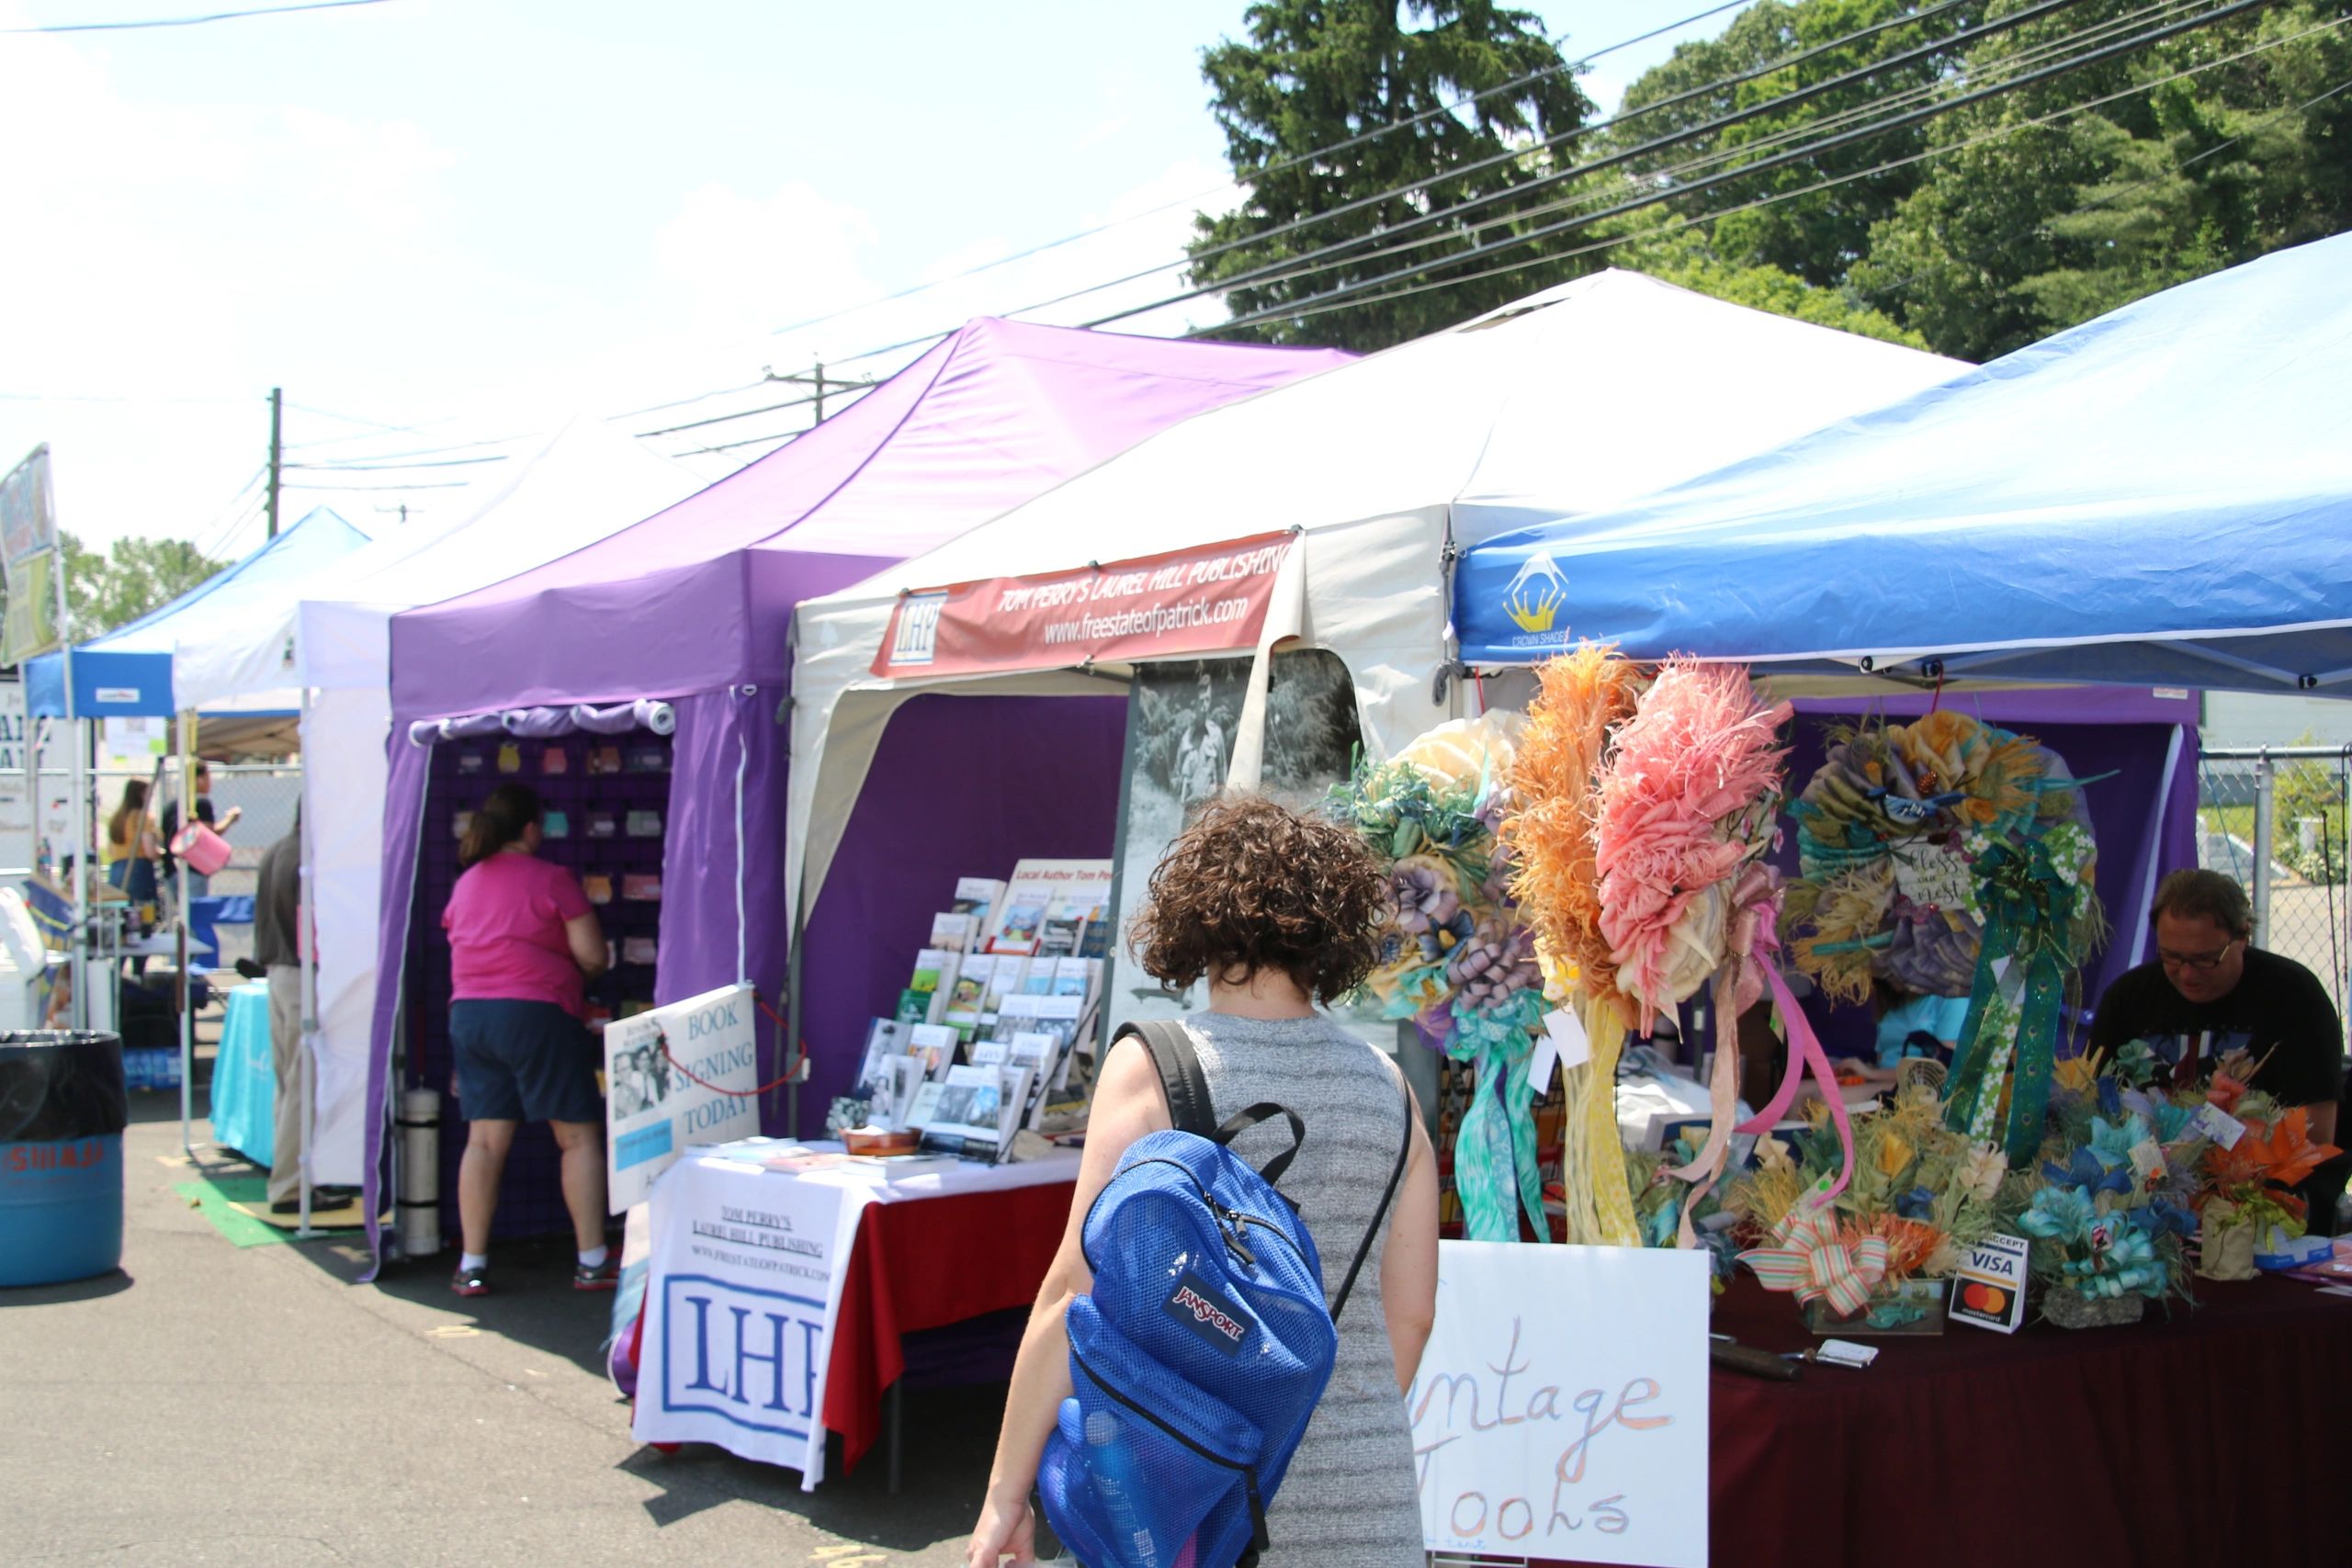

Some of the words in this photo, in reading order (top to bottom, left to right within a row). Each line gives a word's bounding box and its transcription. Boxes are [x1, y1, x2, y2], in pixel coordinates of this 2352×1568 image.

[998, 586, 1032, 612] TOM
[1091, 572, 1148, 601] LAUREL
[1148, 563, 1188, 591] HILL
[1045, 596, 1249, 644] www.freestateofpatrick.com
[1043, 870, 1074, 879] Author
[1076, 870, 1096, 879] Tom
[689, 1001, 739, 1041] BOOK
[674, 1041, 753, 1091] SIGNING
[684, 1090, 749, 1134] TODAY
[1973, 1251, 2012, 1275] VISA
[1172, 1286, 1244, 1341] JANSPORT
[1962, 1308, 2001, 1322] mastercard
